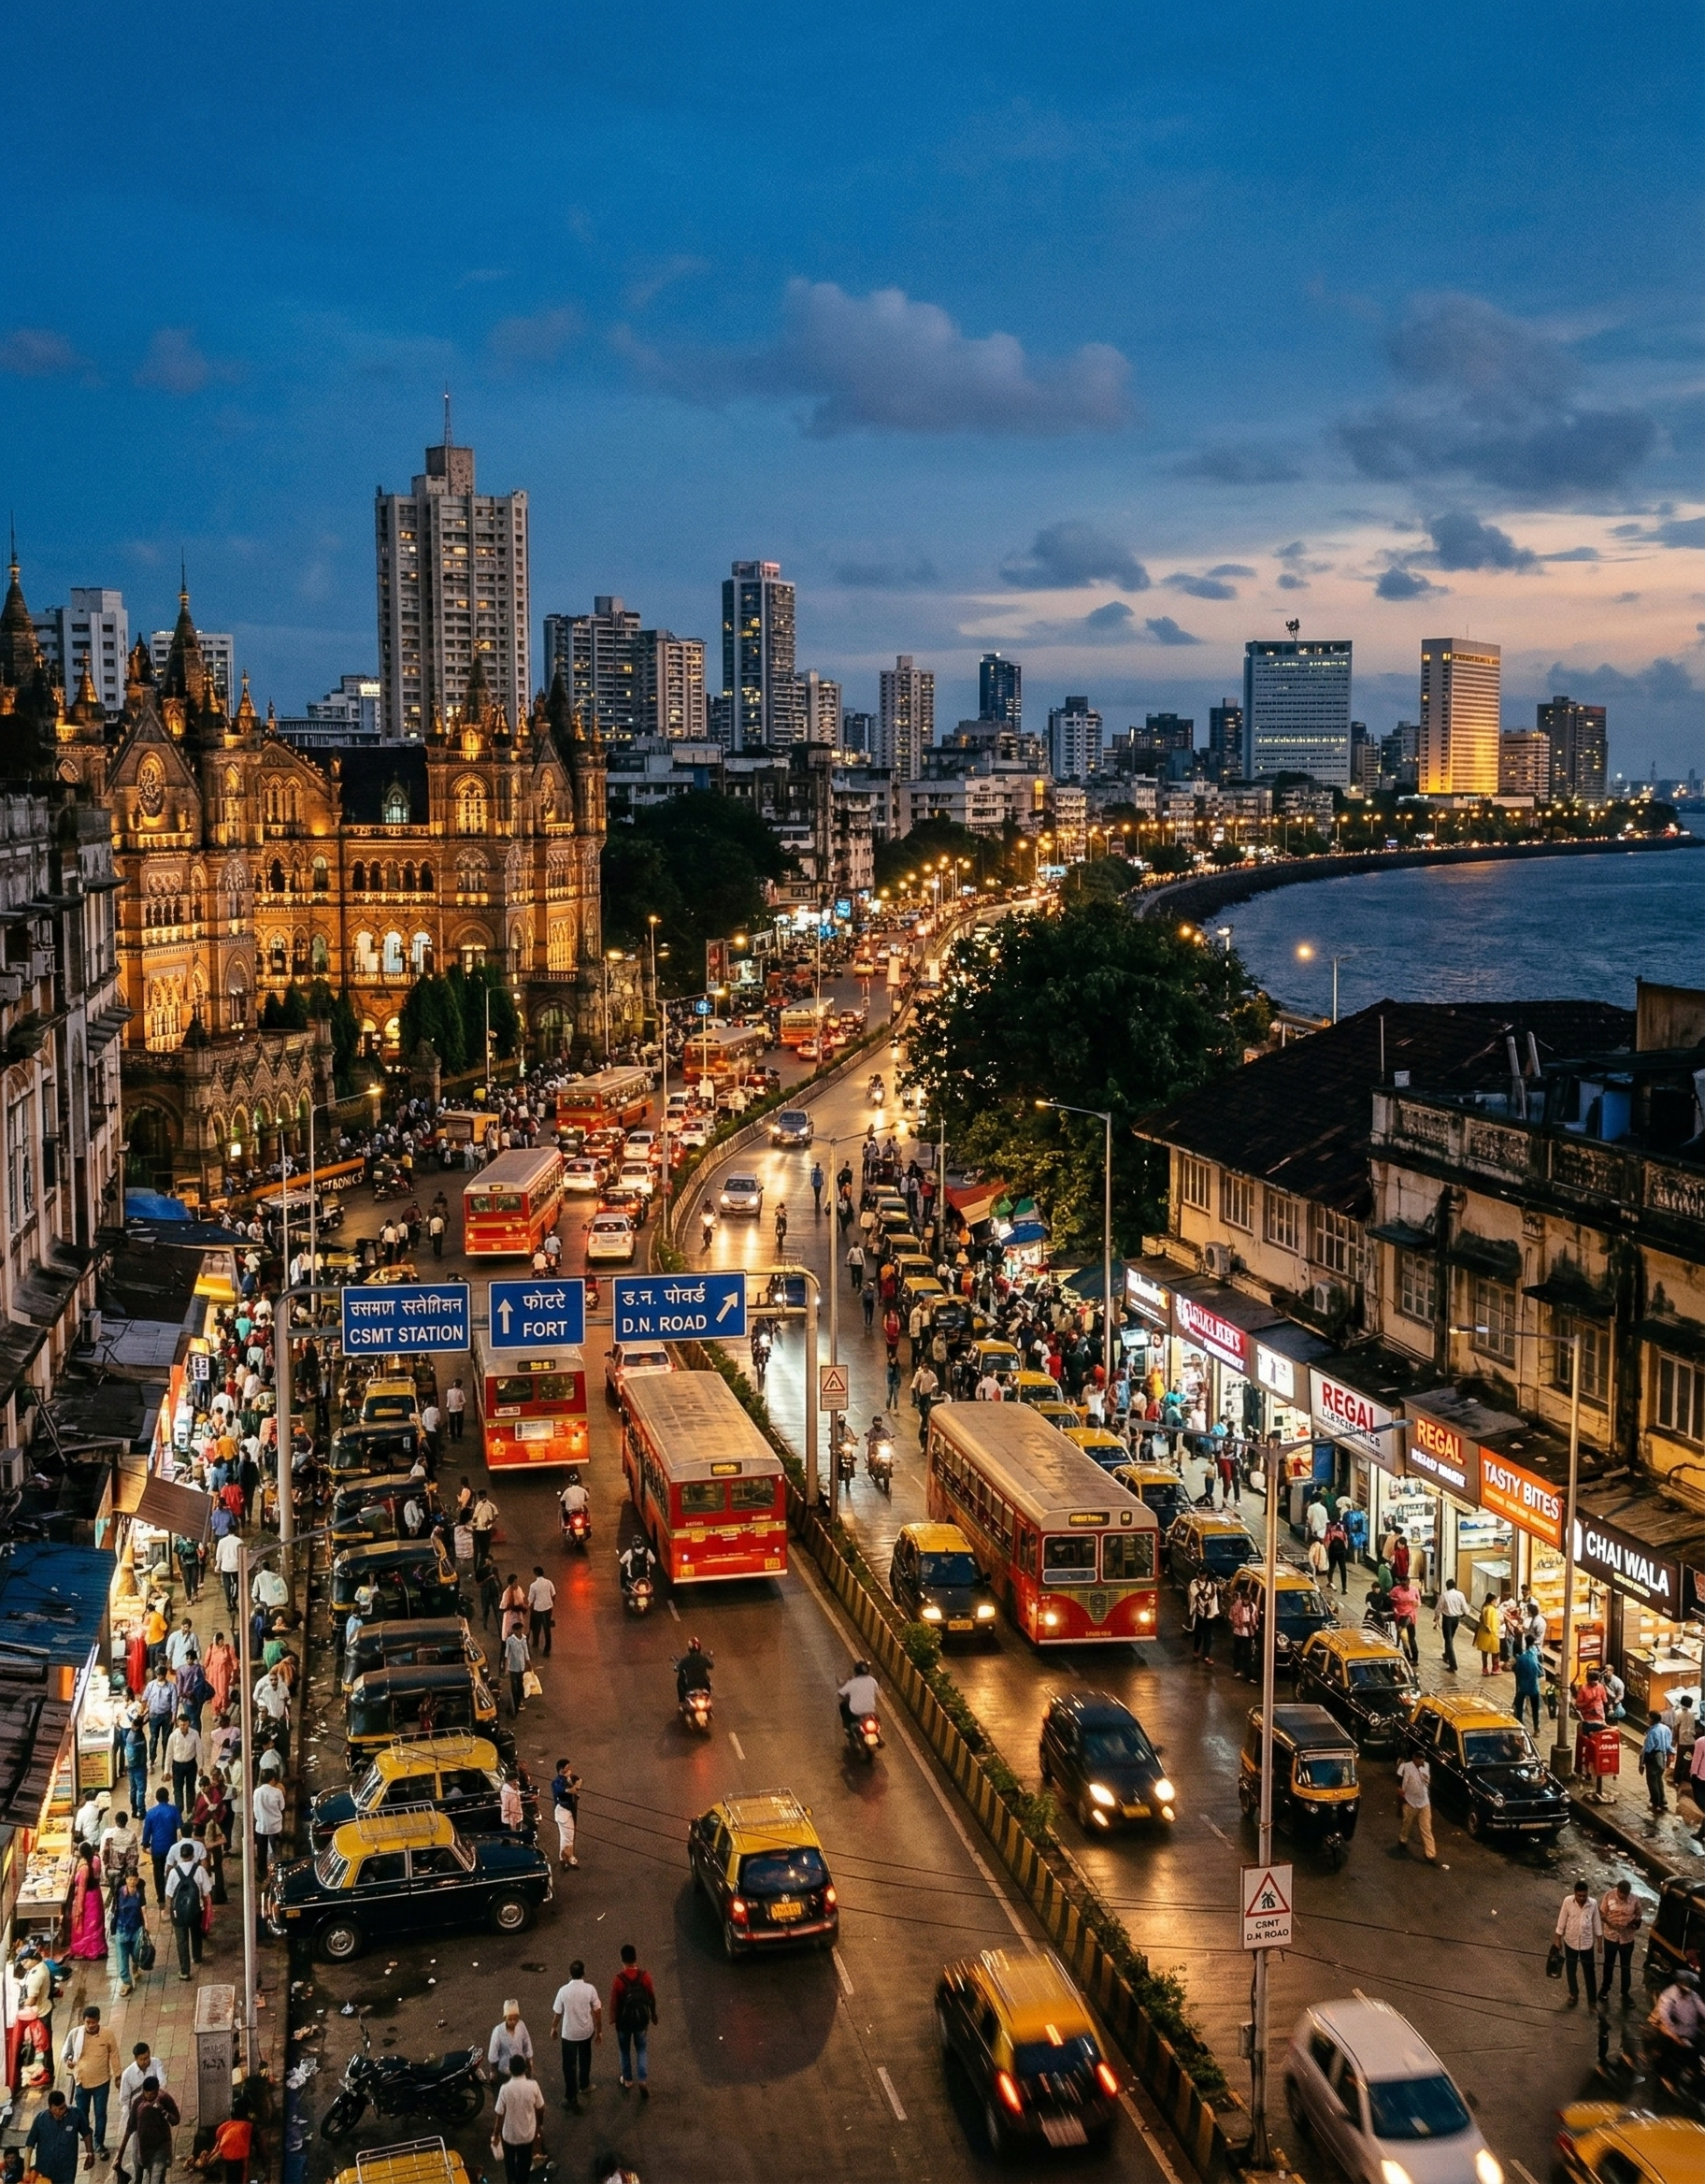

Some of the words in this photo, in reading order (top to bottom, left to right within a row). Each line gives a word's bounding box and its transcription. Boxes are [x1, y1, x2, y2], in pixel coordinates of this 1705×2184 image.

[350, 1328, 394, 1344] CSMT
[398, 1325, 463, 1343] STATION
[523, 1321, 567, 1337] FORT
[623, 1316, 654, 1333] D.N.
[659, 1315, 707, 1331] ROAD
[1322, 1381, 1375, 1434] REGAL
[1417, 1418, 1464, 1466] REGAL
[1483, 1459, 1521, 1499] TASTY
[1523, 1481, 1559, 1521] BITES
[1586, 1530, 1622, 1571] CHAI
[1625, 1549, 1669, 1597] WALA
